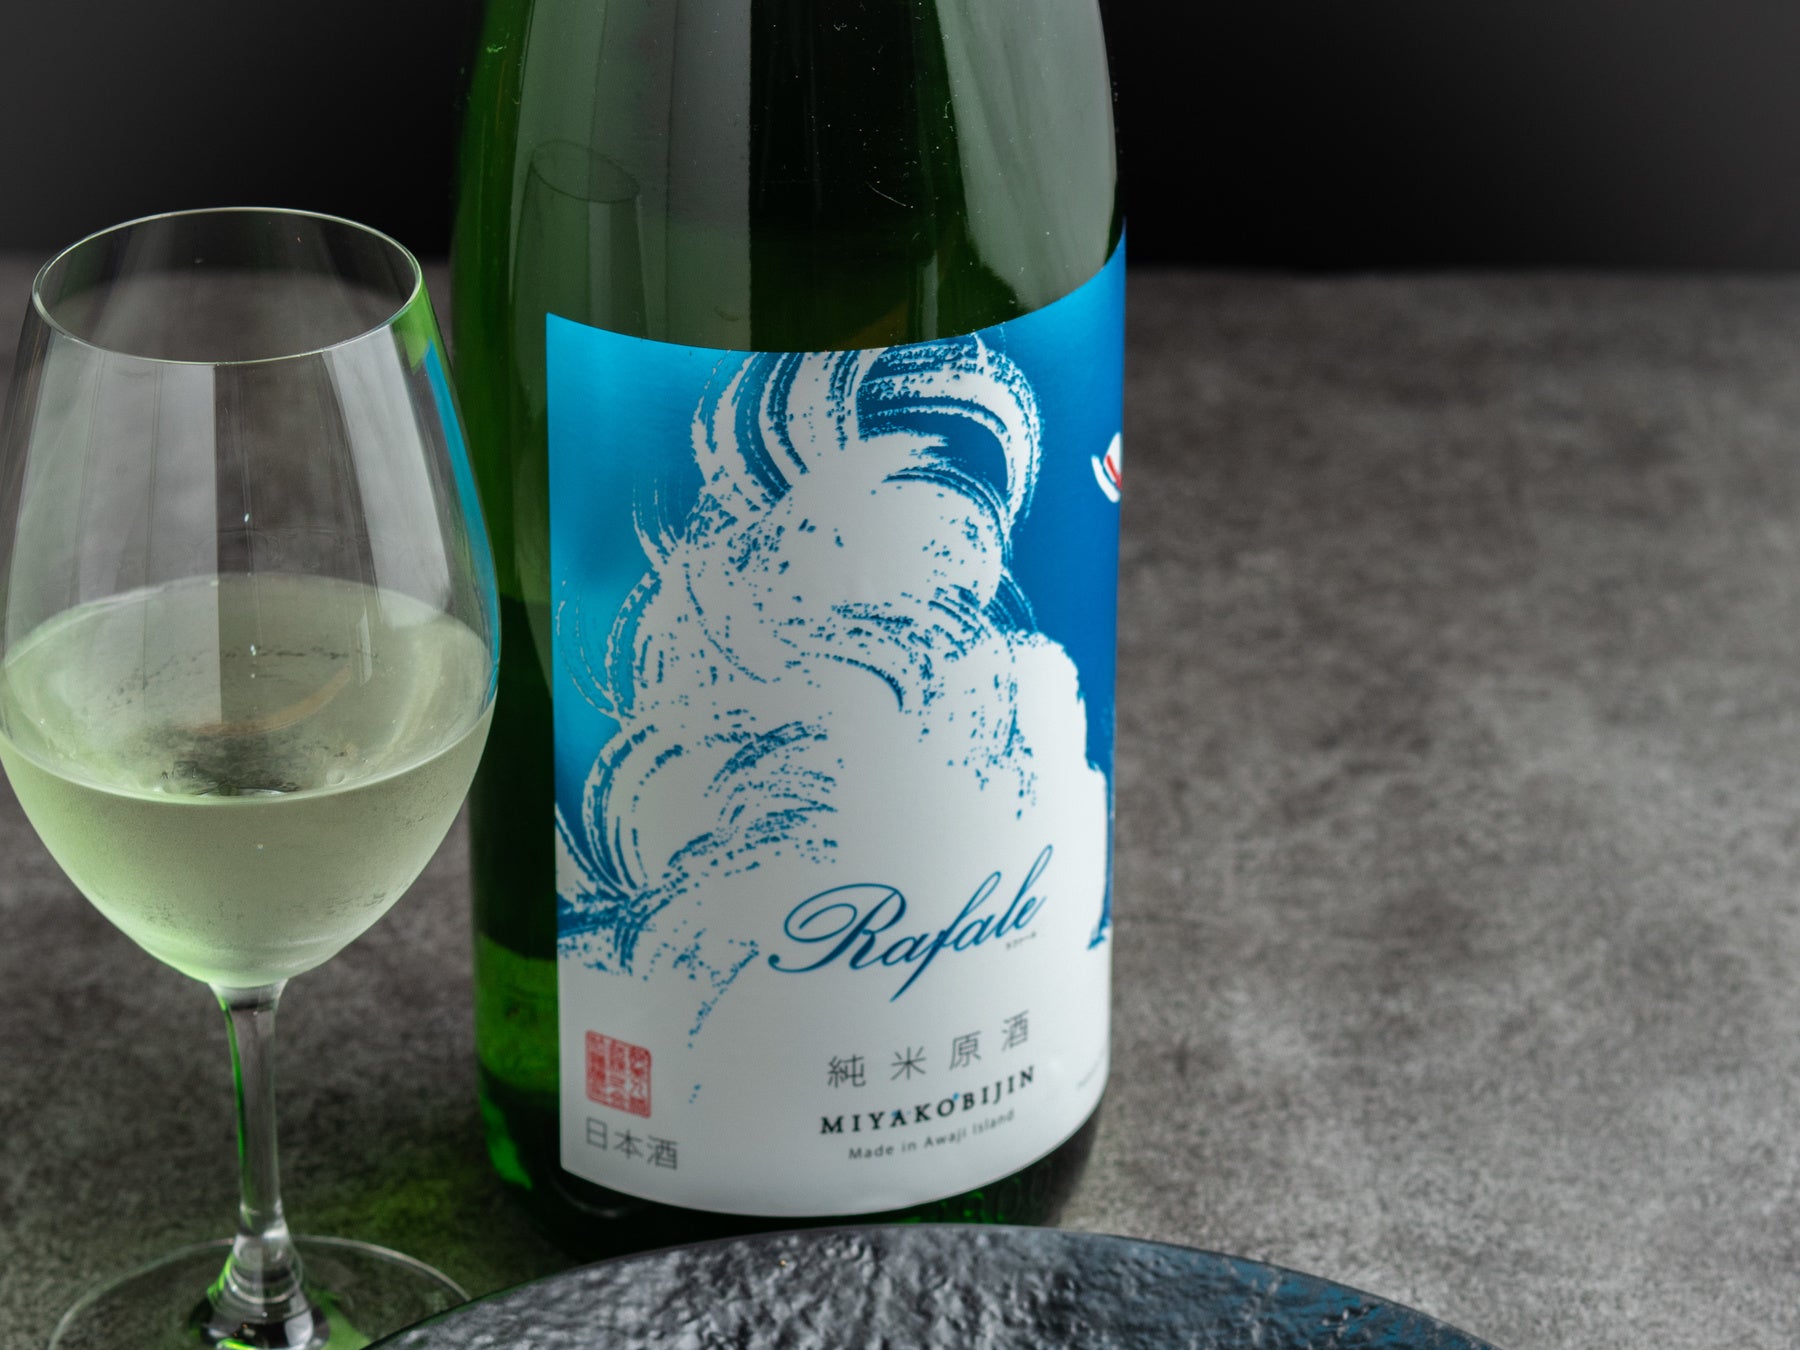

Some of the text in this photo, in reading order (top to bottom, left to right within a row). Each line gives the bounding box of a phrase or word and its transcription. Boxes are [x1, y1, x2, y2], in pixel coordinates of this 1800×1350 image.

[768, 844, 1053, 1002] Rafale
[827, 1009, 1029, 1089] 純米原酒
[820, 1064, 1035, 1134] MIYAKOBIJIN
[586, 1116, 678, 1170] 日本酒
[848, 1109, 1015, 1160] Made in Awaji Island
